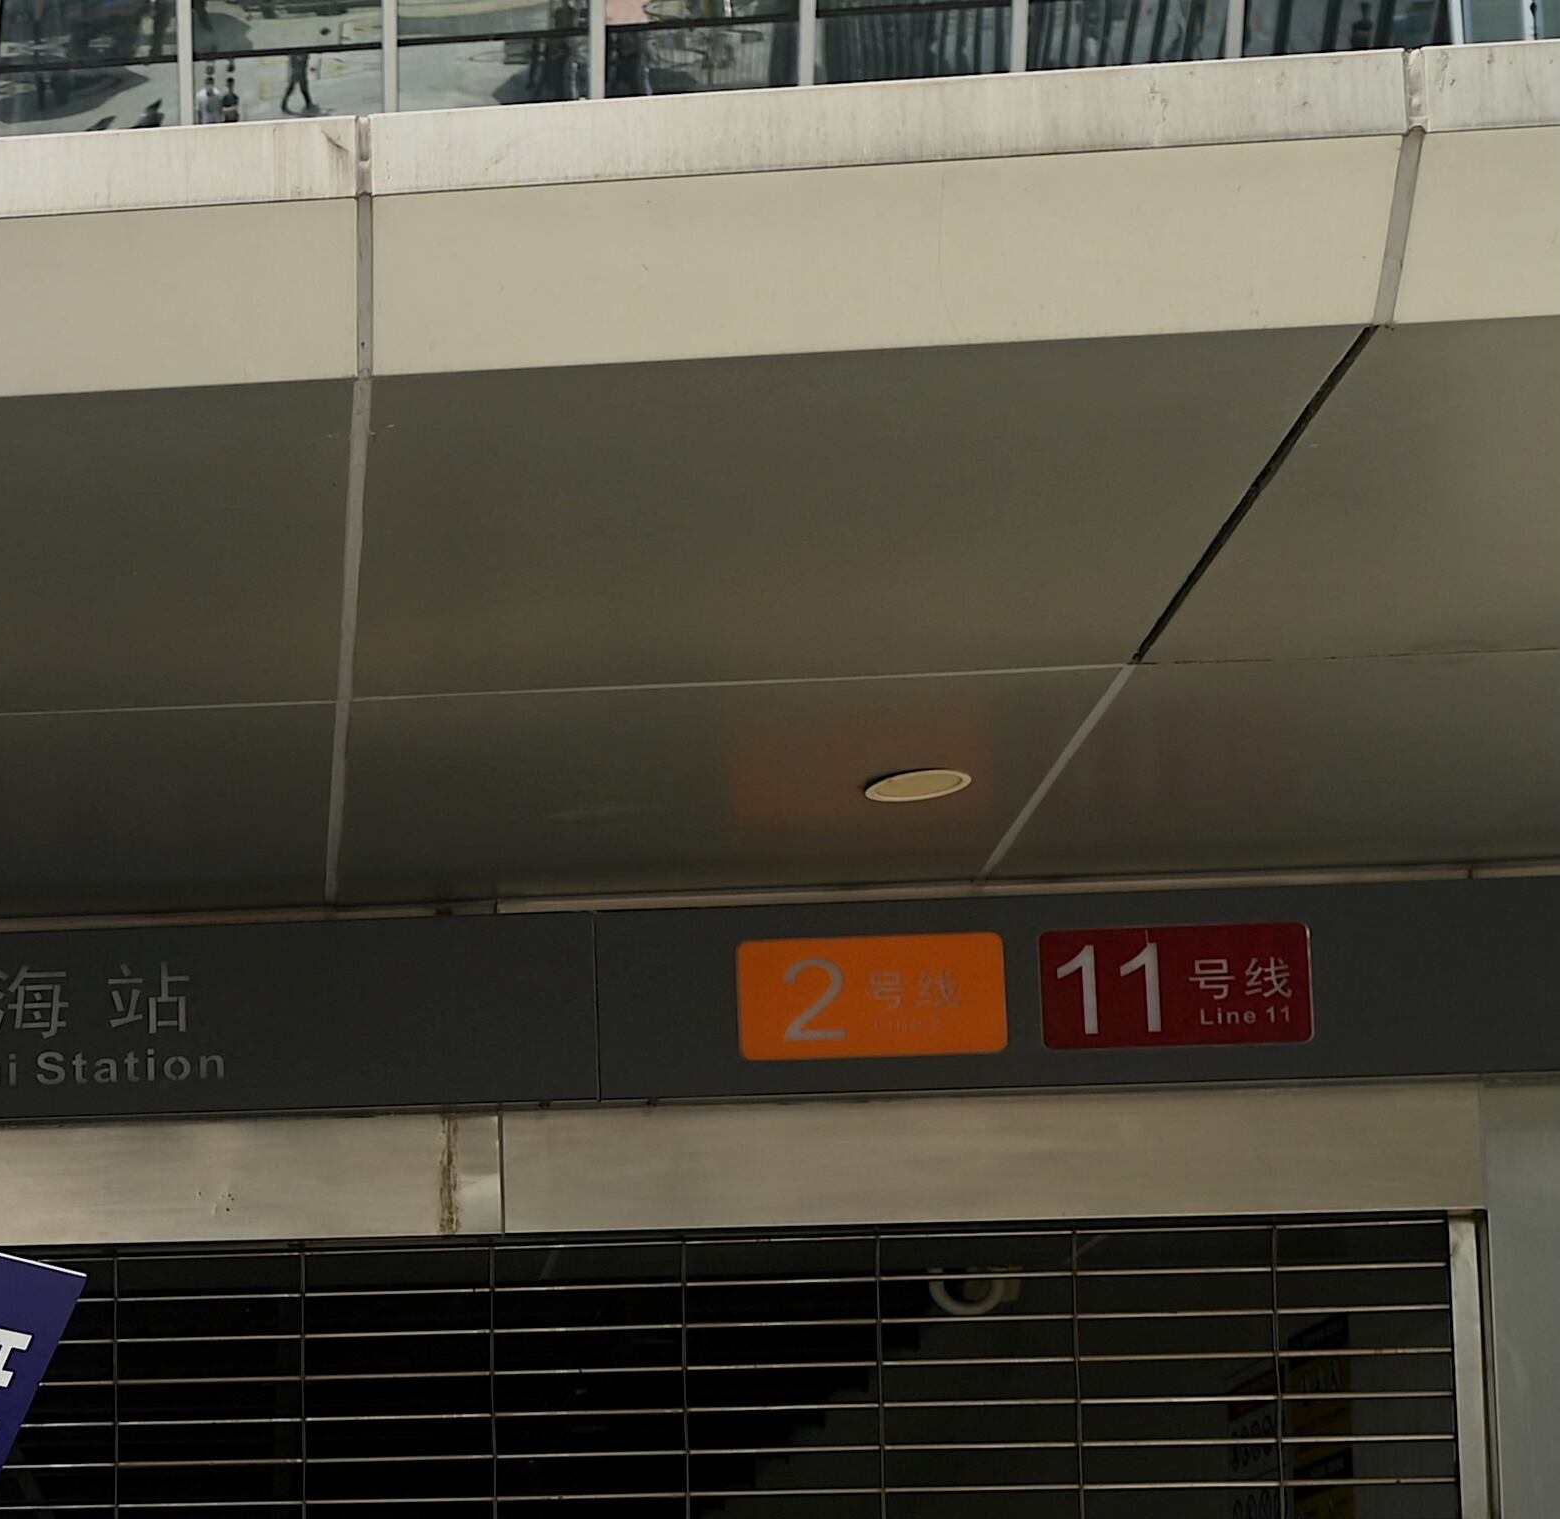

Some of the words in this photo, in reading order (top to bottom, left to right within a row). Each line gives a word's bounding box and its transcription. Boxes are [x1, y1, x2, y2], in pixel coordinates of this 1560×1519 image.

[782, 957, 847, 1041] 2
[866, 967, 962, 1011] 号线
[1056, 942, 1162, 1035] 11
[1188, 956, 1293, 1000] 号线
[1200, 1008, 1256, 1026] Line
[1265, 1006, 1290, 1023] 11
[35, 1049, 224, 1085] Station
